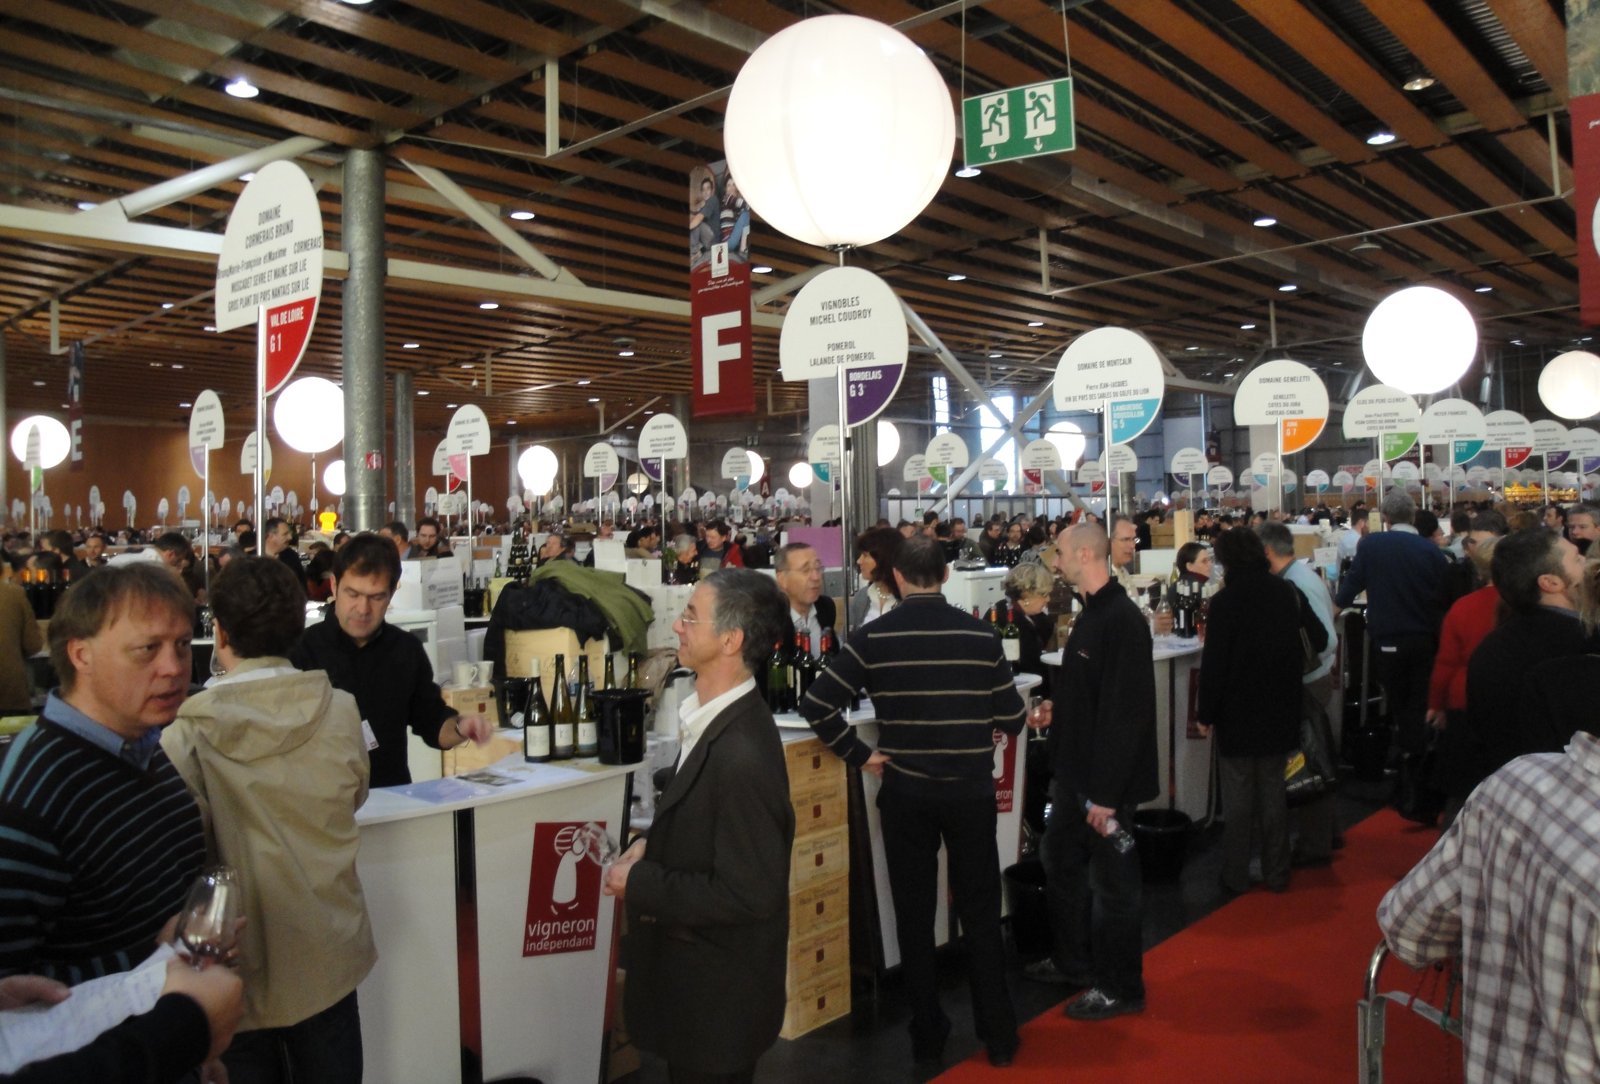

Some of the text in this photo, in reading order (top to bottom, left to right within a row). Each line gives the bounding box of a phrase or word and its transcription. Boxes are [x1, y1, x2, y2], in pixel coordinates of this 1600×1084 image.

[258, 204, 281, 226] DOMAINE
[245, 219, 294, 249] CORMERAIS BRUNO
[293, 235, 322, 254] CORMERAIS
[288, 261, 298, 276] SUR
[299, 258, 307, 272] LIE
[259, 289, 271, 304] PAYS
[271, 283, 290, 300] NANTAIS
[291, 280, 301, 295] SUR
[301, 277, 310, 292] LIE
[820, 296, 860, 311] VIGNOBLES
[270, 306, 304, 328] VAL DE LOIRE
[809, 308, 872, 326] MICHEL COUDROY
[269, 332, 282, 353] G 1
[827, 340, 856, 351] POMEROL
[701, 310, 742, 396] F
[809, 351, 876, 366] LALANDE DE POMEROL
[1077, 361, 1098, 371] DOMAINE
[1098, 360, 1105, 368] DE
[849, 369, 883, 382] BORDELAIS
[849, 383, 864, 398] G 3
[71, 419, 83, 462] E
[528, 918, 595, 940] vigneron
[525, 935, 593, 952] independant
